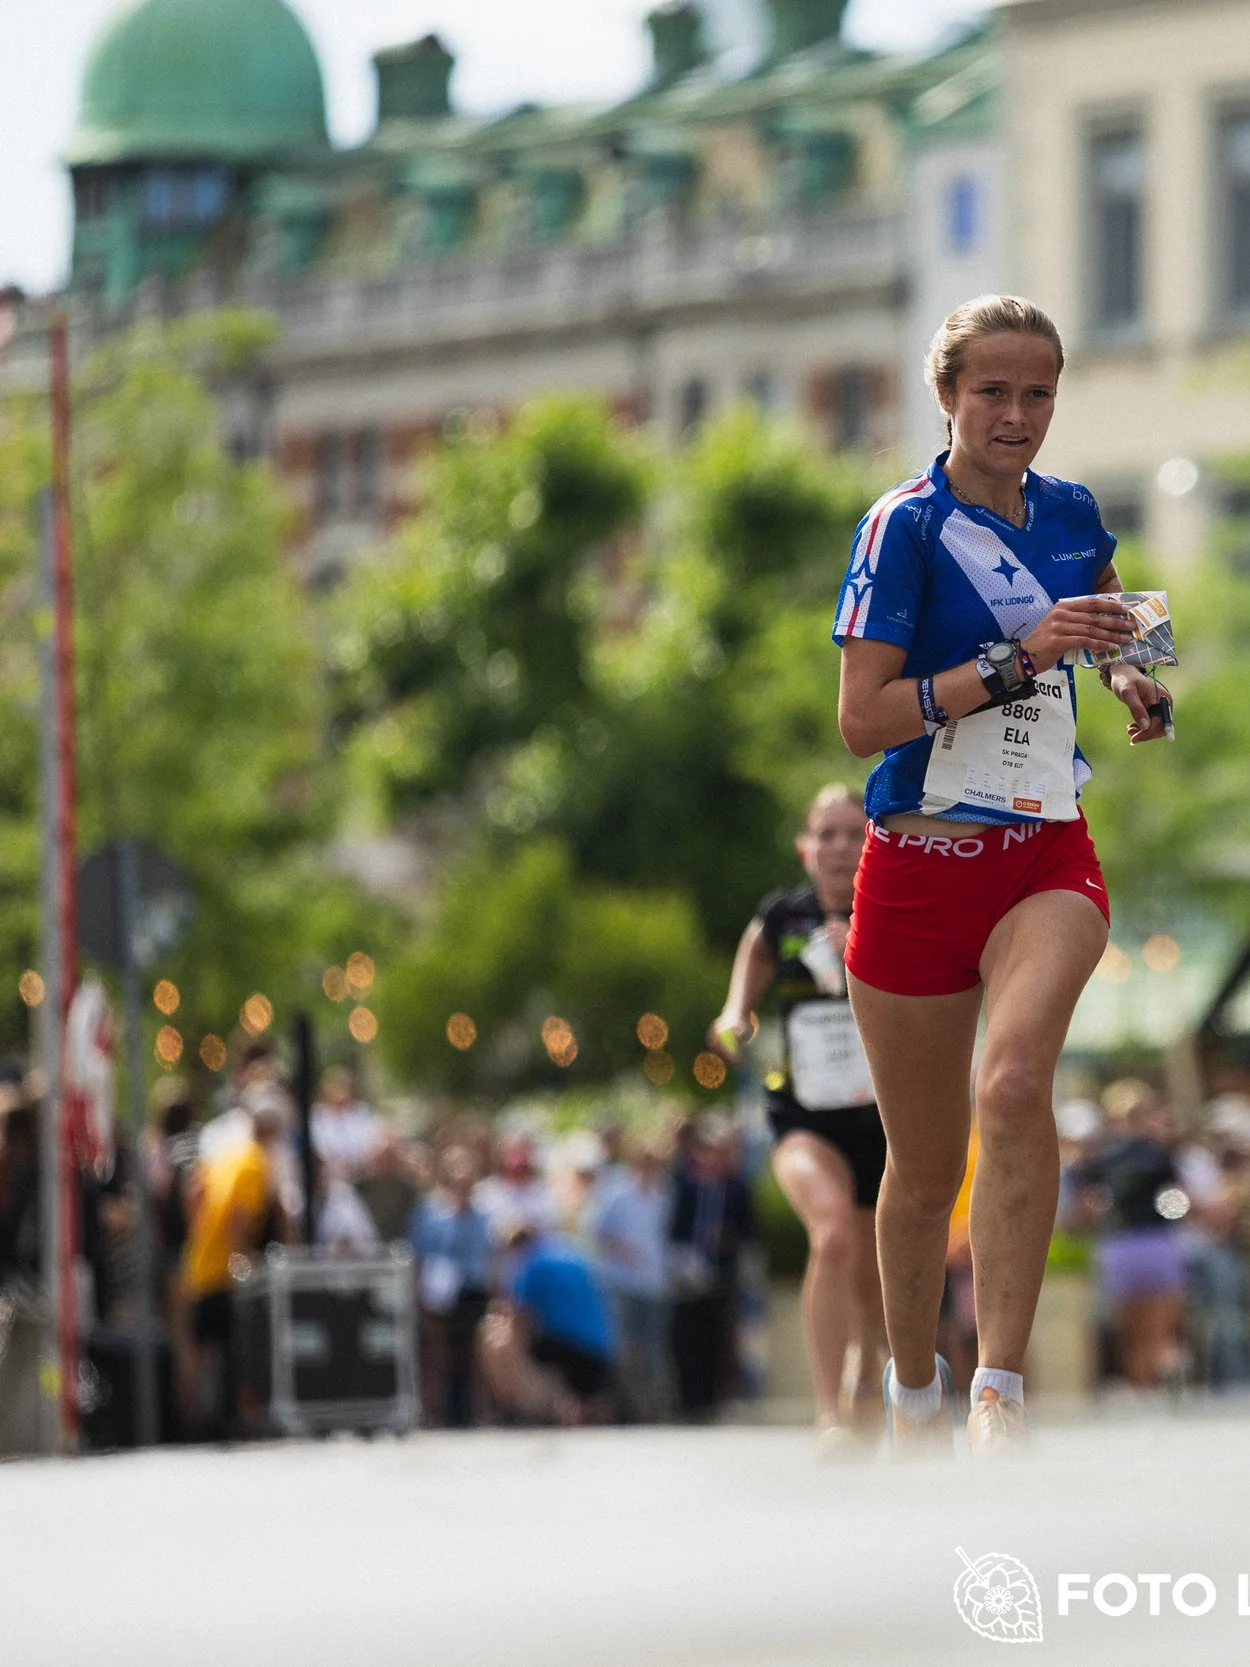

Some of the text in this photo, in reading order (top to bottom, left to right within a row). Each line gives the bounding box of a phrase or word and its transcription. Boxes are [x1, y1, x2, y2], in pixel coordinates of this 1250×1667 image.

[990, 599, 1003, 607] IFK
[1001, 702, 1041, 722] 8805
[1003, 727, 1030, 746] ELA
[964, 788, 1006, 803] CHALMERS
[898, 833, 984, 858] PRO
